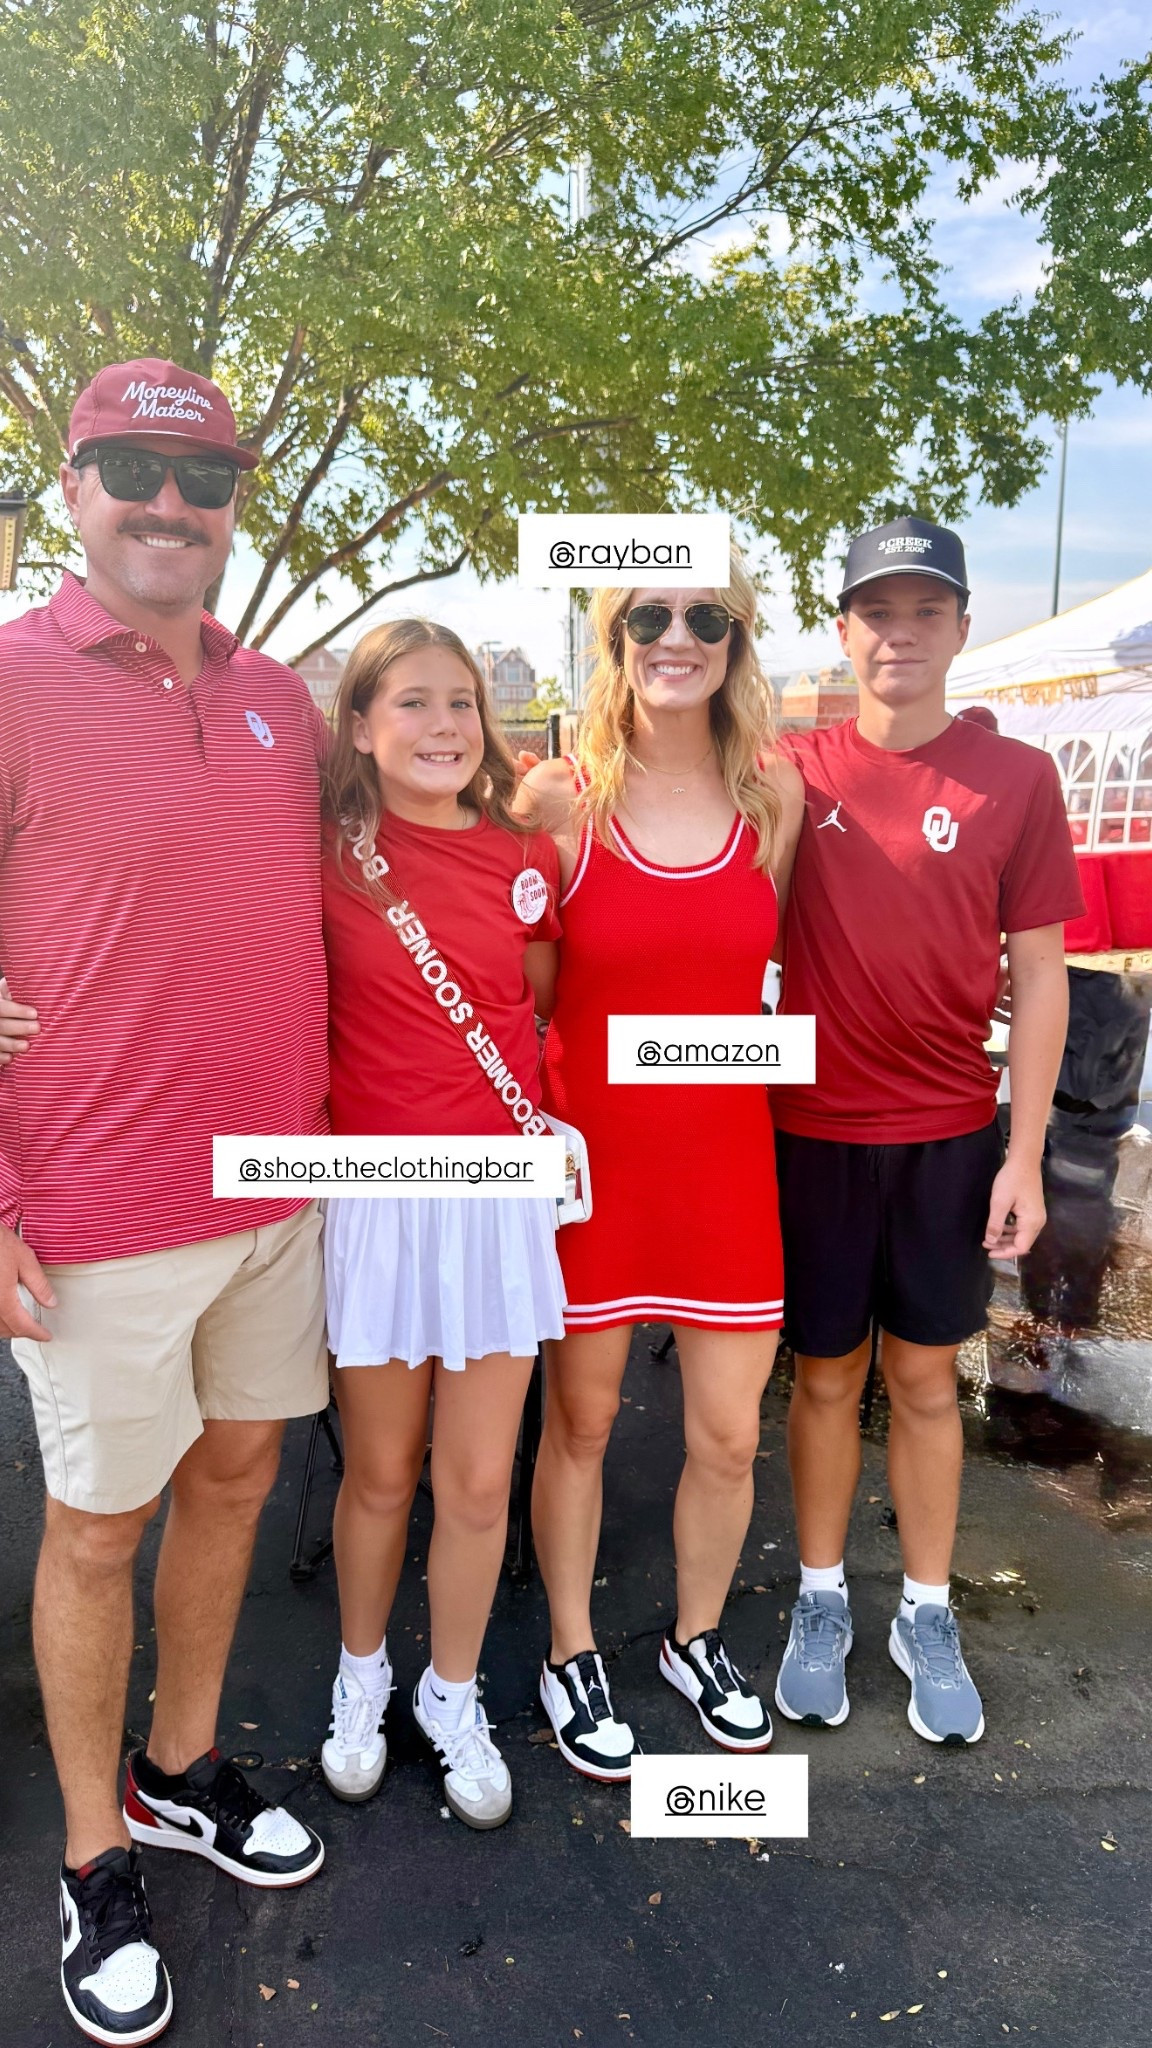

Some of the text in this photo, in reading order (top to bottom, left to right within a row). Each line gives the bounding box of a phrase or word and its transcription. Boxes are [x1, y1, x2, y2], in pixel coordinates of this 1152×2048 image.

[121, 381, 213, 410] Moneyline
[132, 399, 205, 423] Mateer
[921, 805, 960, 853] OU
[385, 900, 474, 1024] SOONER
[466, 1022, 546, 1136] BOOMER
